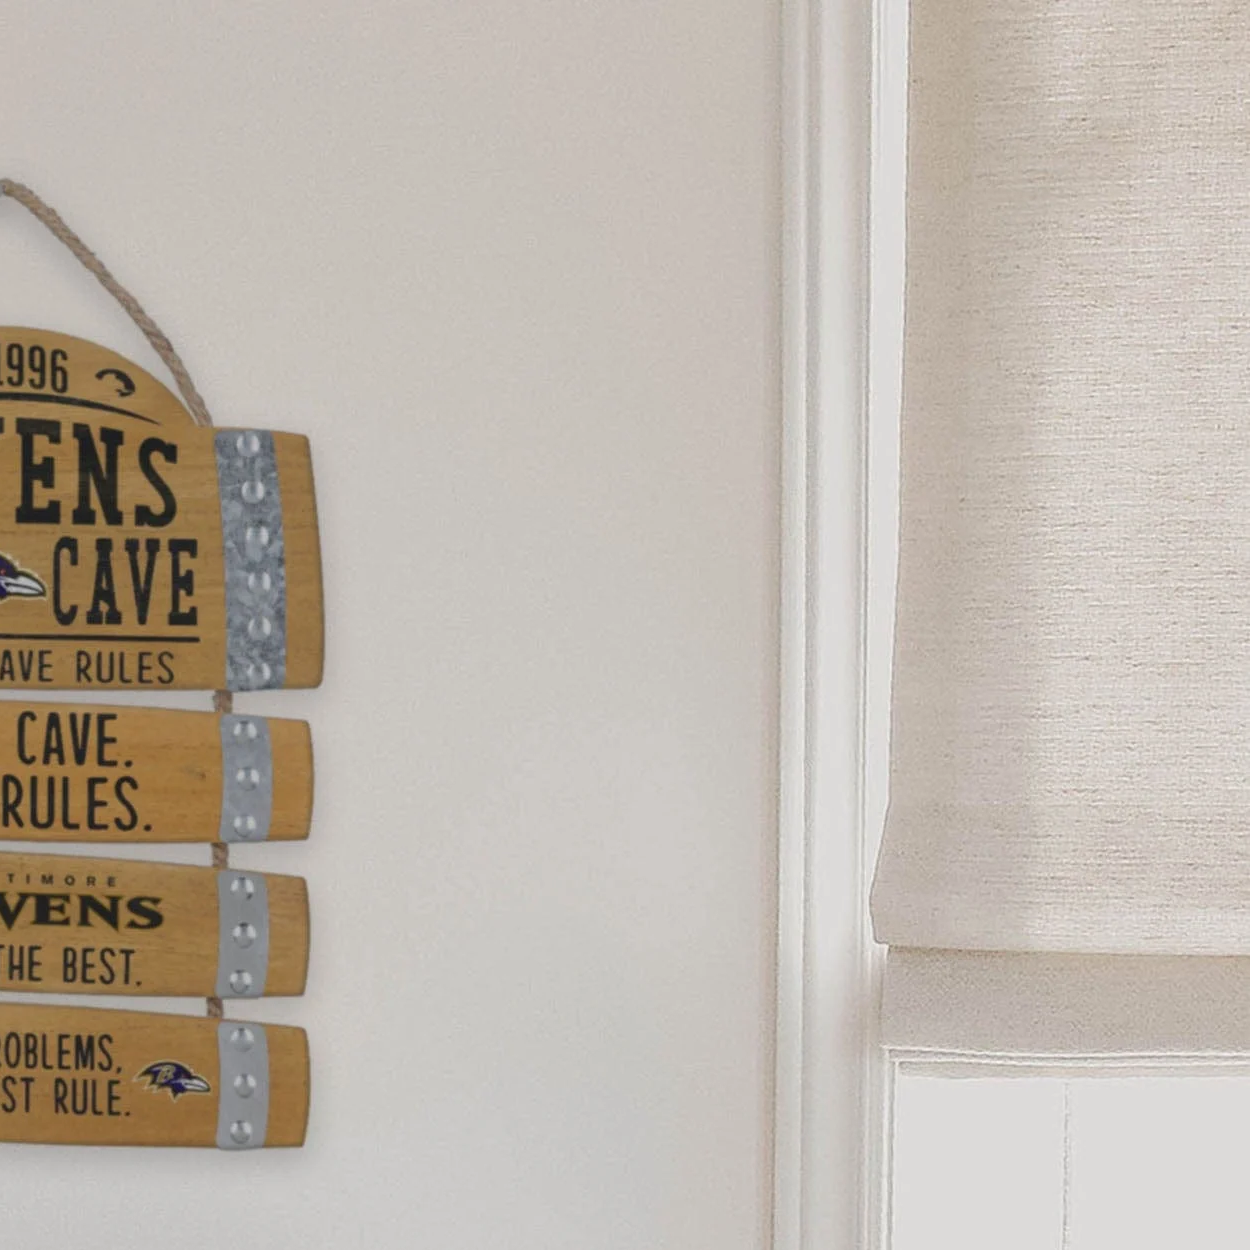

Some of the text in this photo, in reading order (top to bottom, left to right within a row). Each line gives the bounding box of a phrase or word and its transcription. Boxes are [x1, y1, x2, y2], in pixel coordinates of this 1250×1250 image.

[53, 536, 198, 626] CAVE
[76, 650, 175, 684] RULES
[17, 711, 133, 768] CAVE.
[2, 774, 153, 832] RULES.
[63, 947, 142, 987] BEST.
[55, 1078, 131, 1117] RULE.
